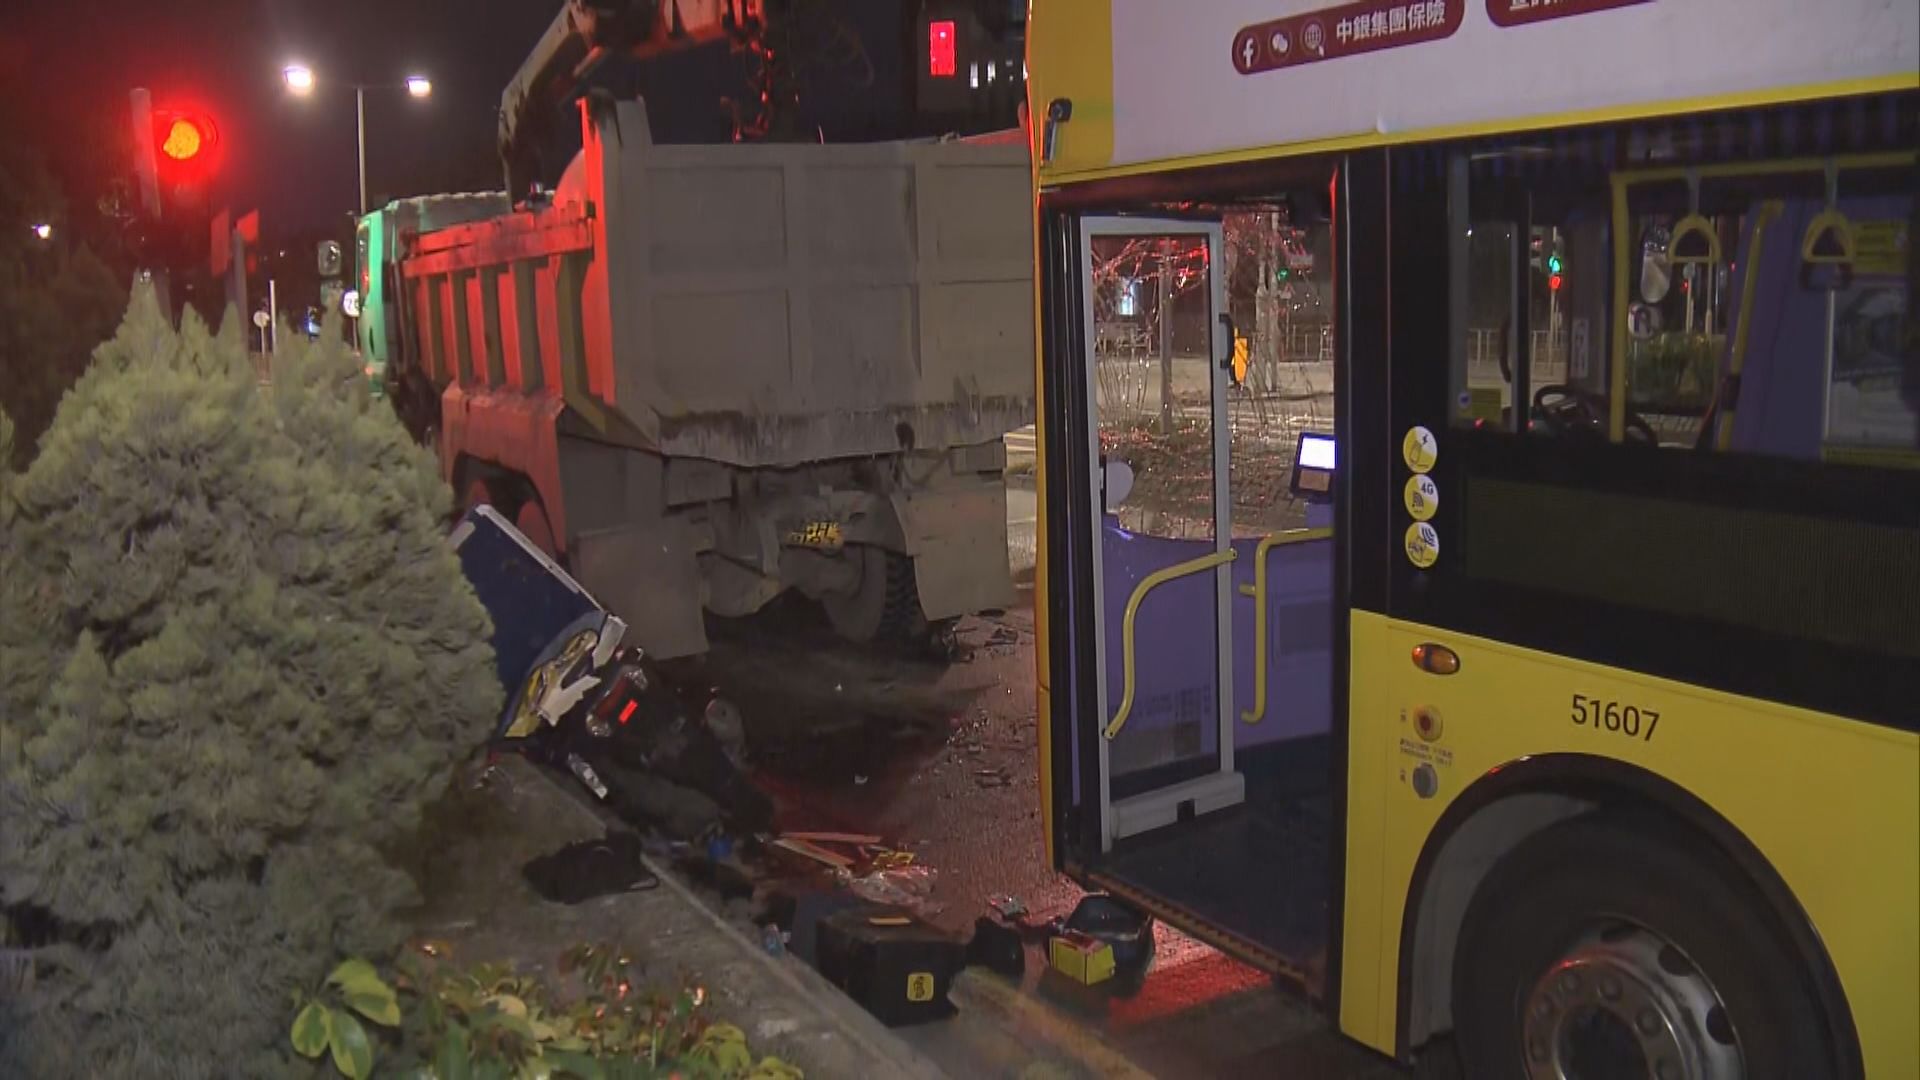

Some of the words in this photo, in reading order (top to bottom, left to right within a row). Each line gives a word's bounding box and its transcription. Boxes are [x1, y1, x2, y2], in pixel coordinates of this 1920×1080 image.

[1336, 1, 1446, 45] 中銀集團保險
[1420, 482, 1434, 496] 4G
[1571, 693, 1660, 742] 51607
